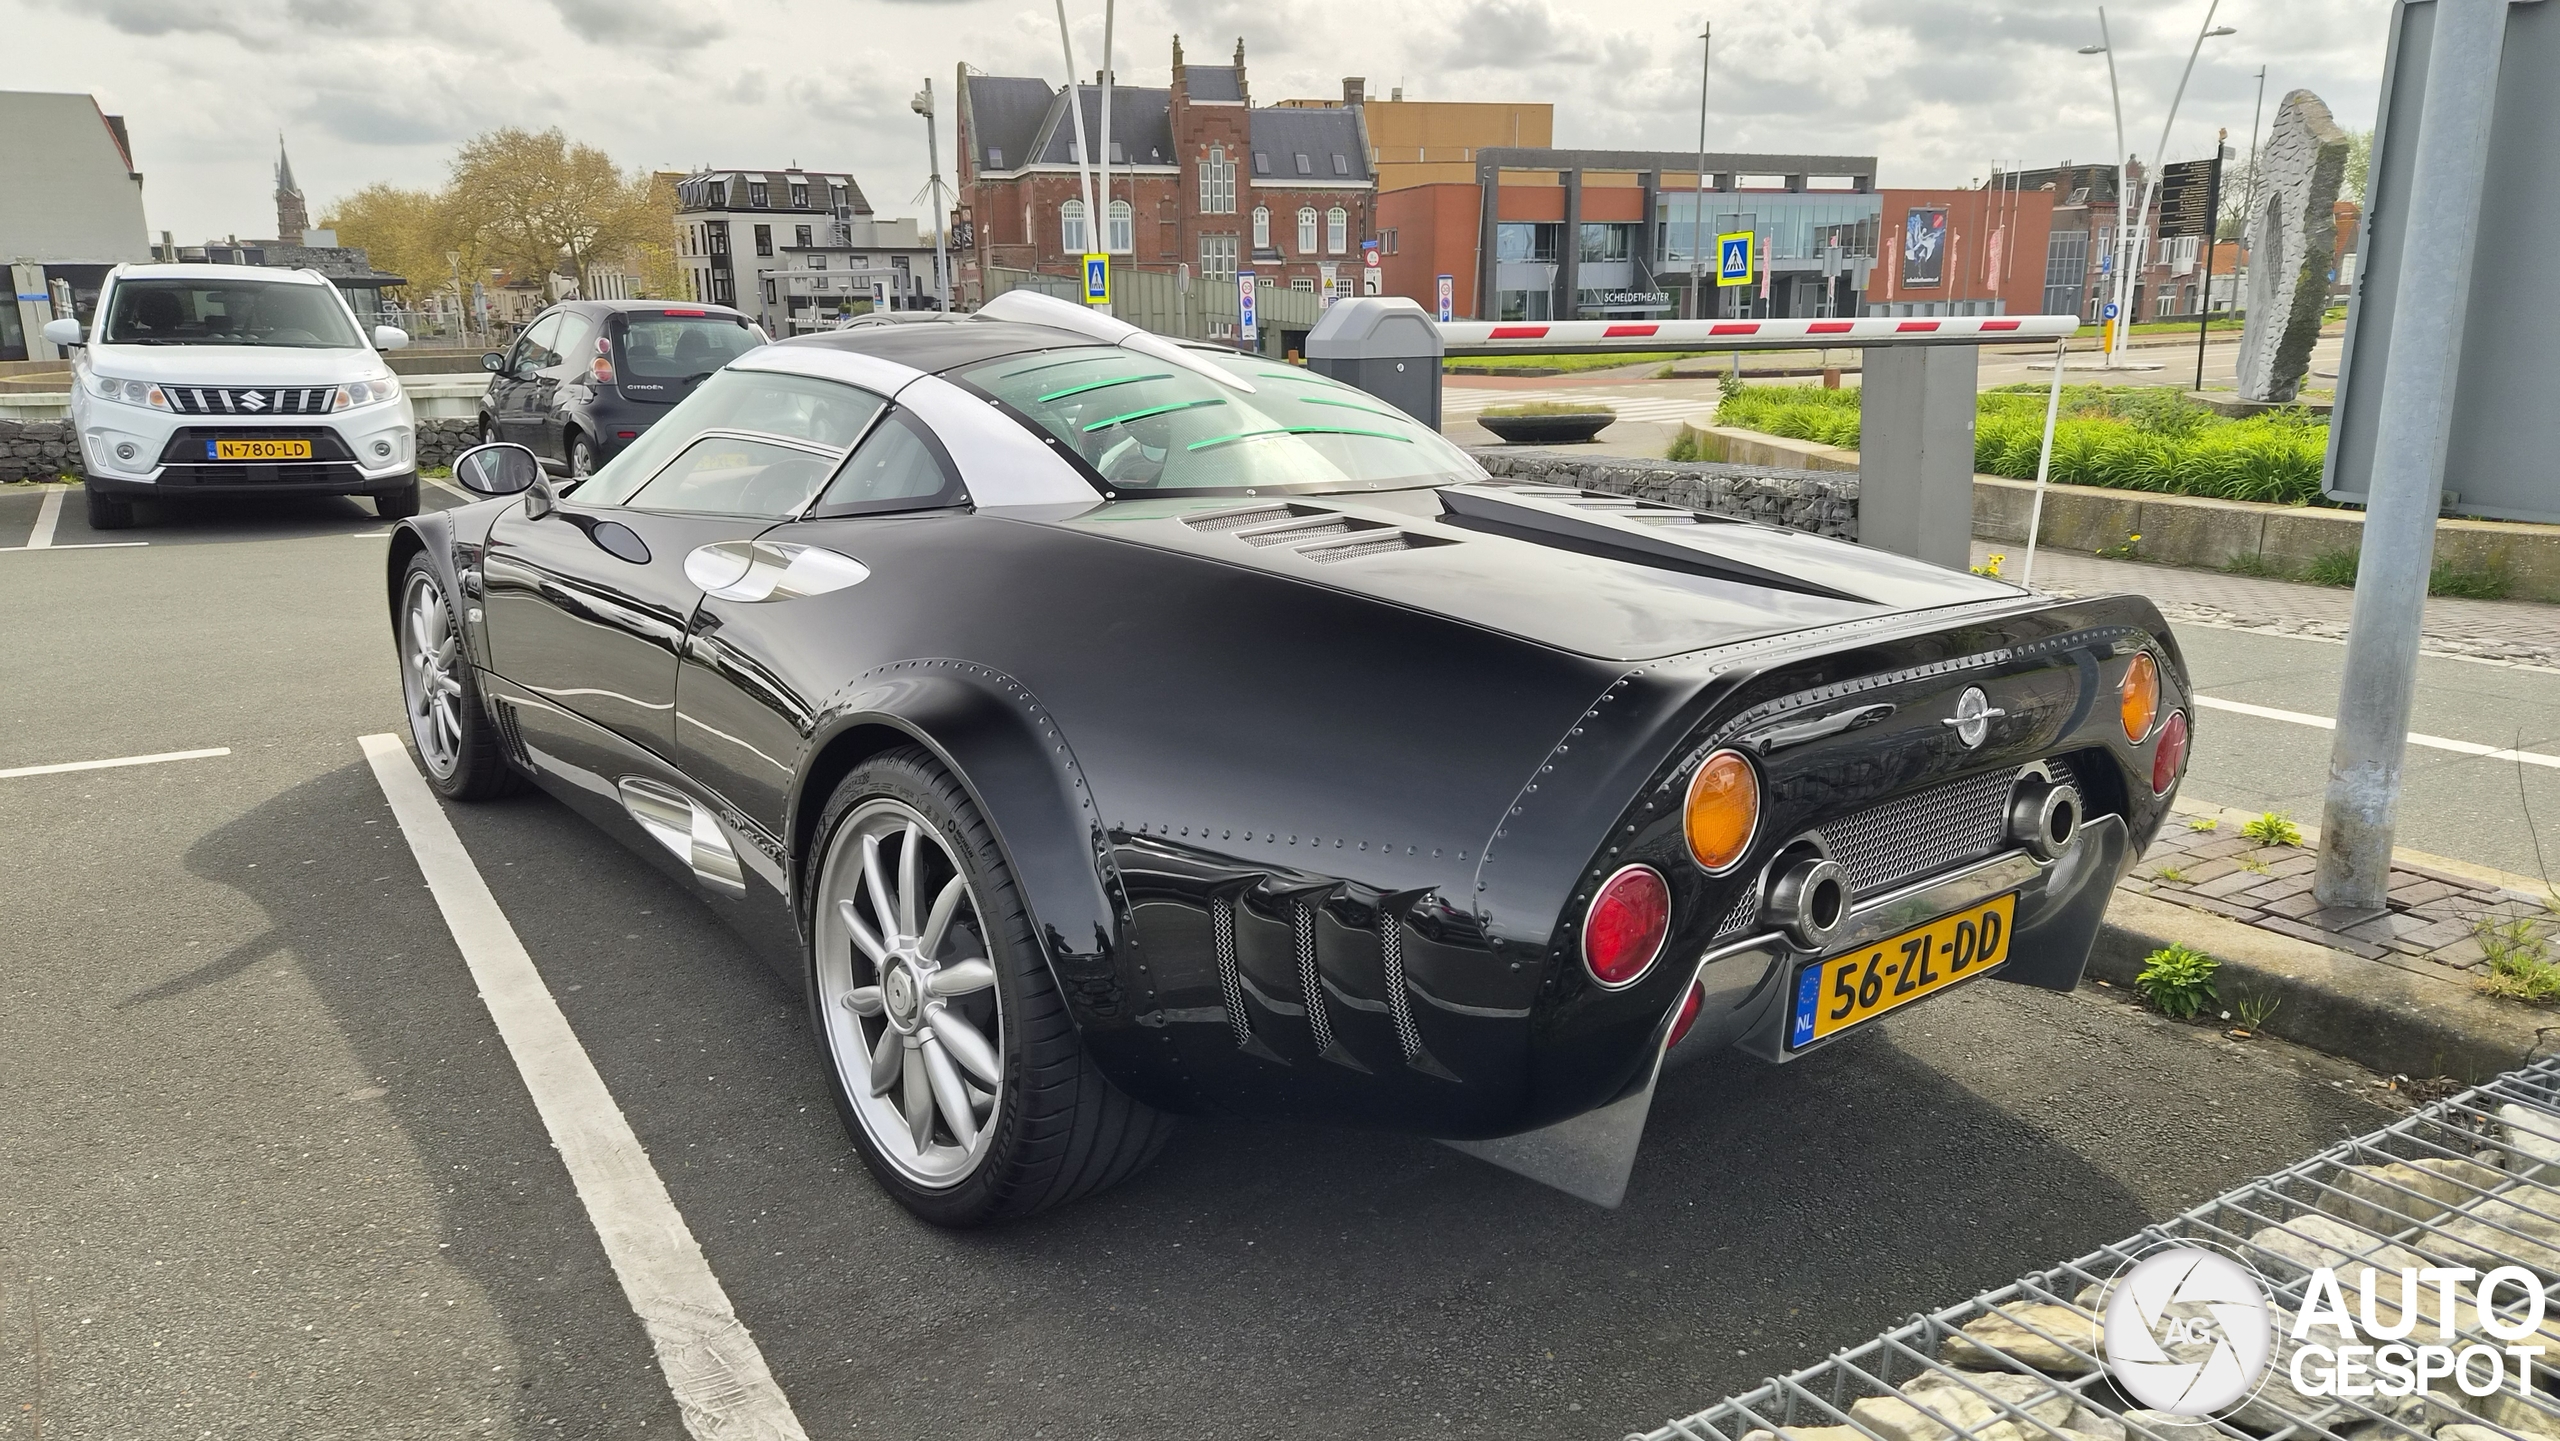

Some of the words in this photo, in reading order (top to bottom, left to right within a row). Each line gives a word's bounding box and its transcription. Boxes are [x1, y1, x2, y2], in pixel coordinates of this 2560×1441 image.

[1604, 292, 1670, 303] SCHELDETHEATER
[223, 443, 305, 458] N-780-LD
[1831, 911, 2002, 1020] 56-ZL-DD
[1796, 1014, 1812, 1034] NL
